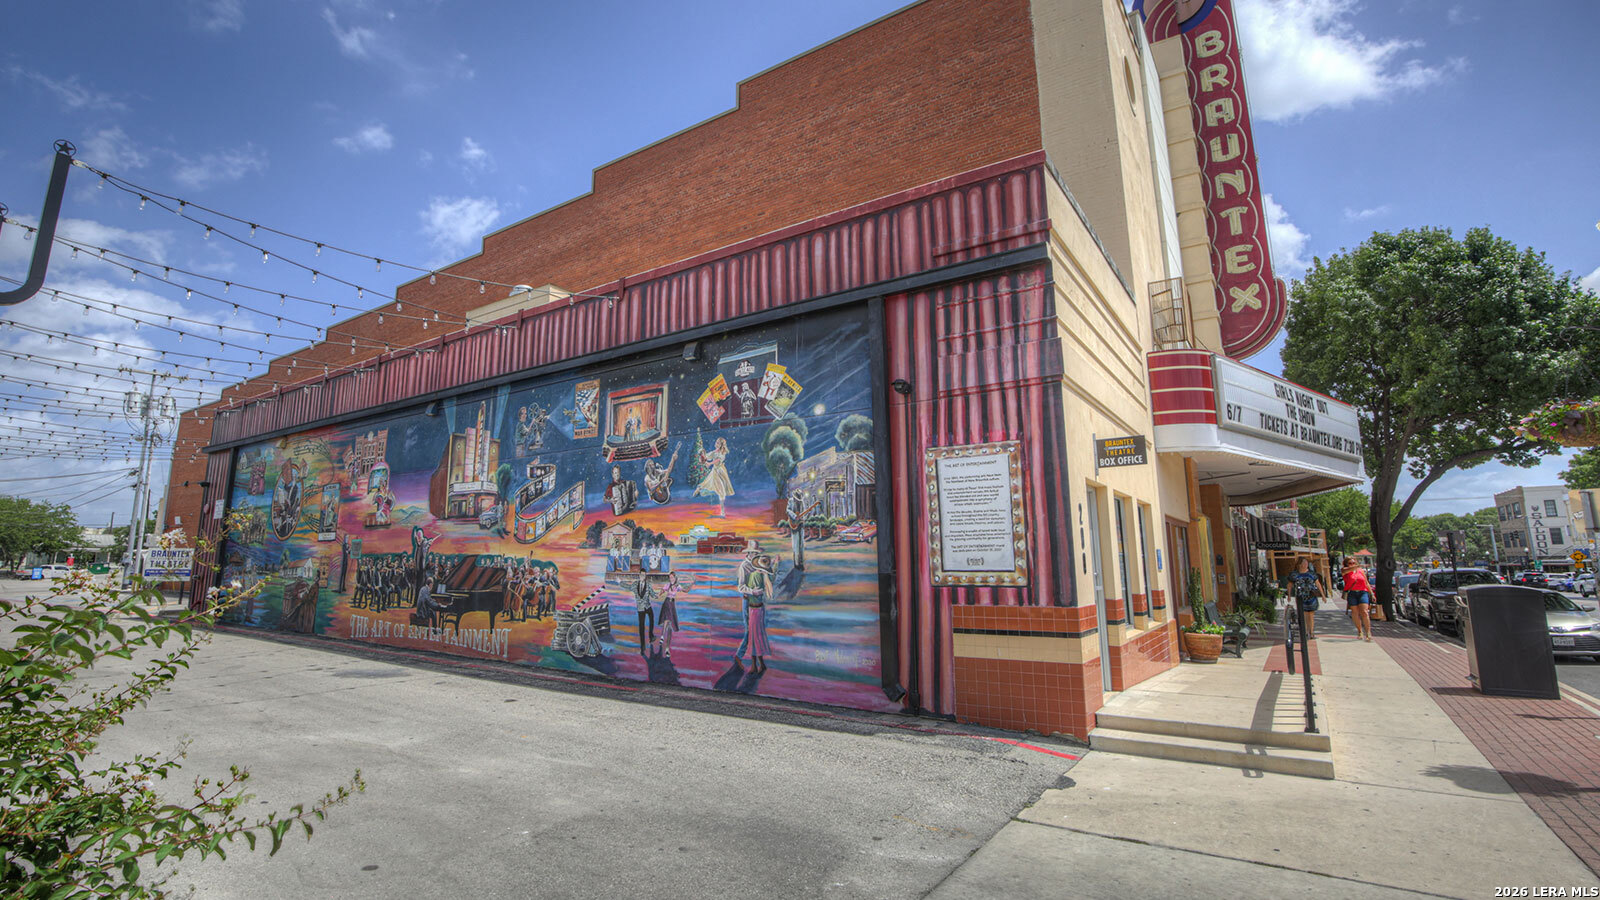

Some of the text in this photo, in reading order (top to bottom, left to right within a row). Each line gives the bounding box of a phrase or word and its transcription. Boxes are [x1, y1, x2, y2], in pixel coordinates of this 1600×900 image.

[1195, 30, 1263, 313] BRAUNTEX
[1274, 382, 1329, 416] GIRLS NIGHT OUT
[1285, 403, 1316, 427] THE SHOW
[1226, 403, 1243, 423] 6/7
[1260, 412, 1289, 436] TICKETS
[1290, 421, 1300, 440] AT
[1104, 438, 1135, 447] BRAUNTEX
[1106, 447, 1136, 456] THEATRE
[1099, 455, 1144, 467] BOX OFFICE
[1531, 512, 1550, 555] SALOON
[350, 614, 513, 658] THE ART OF ENTERTAINMENT
